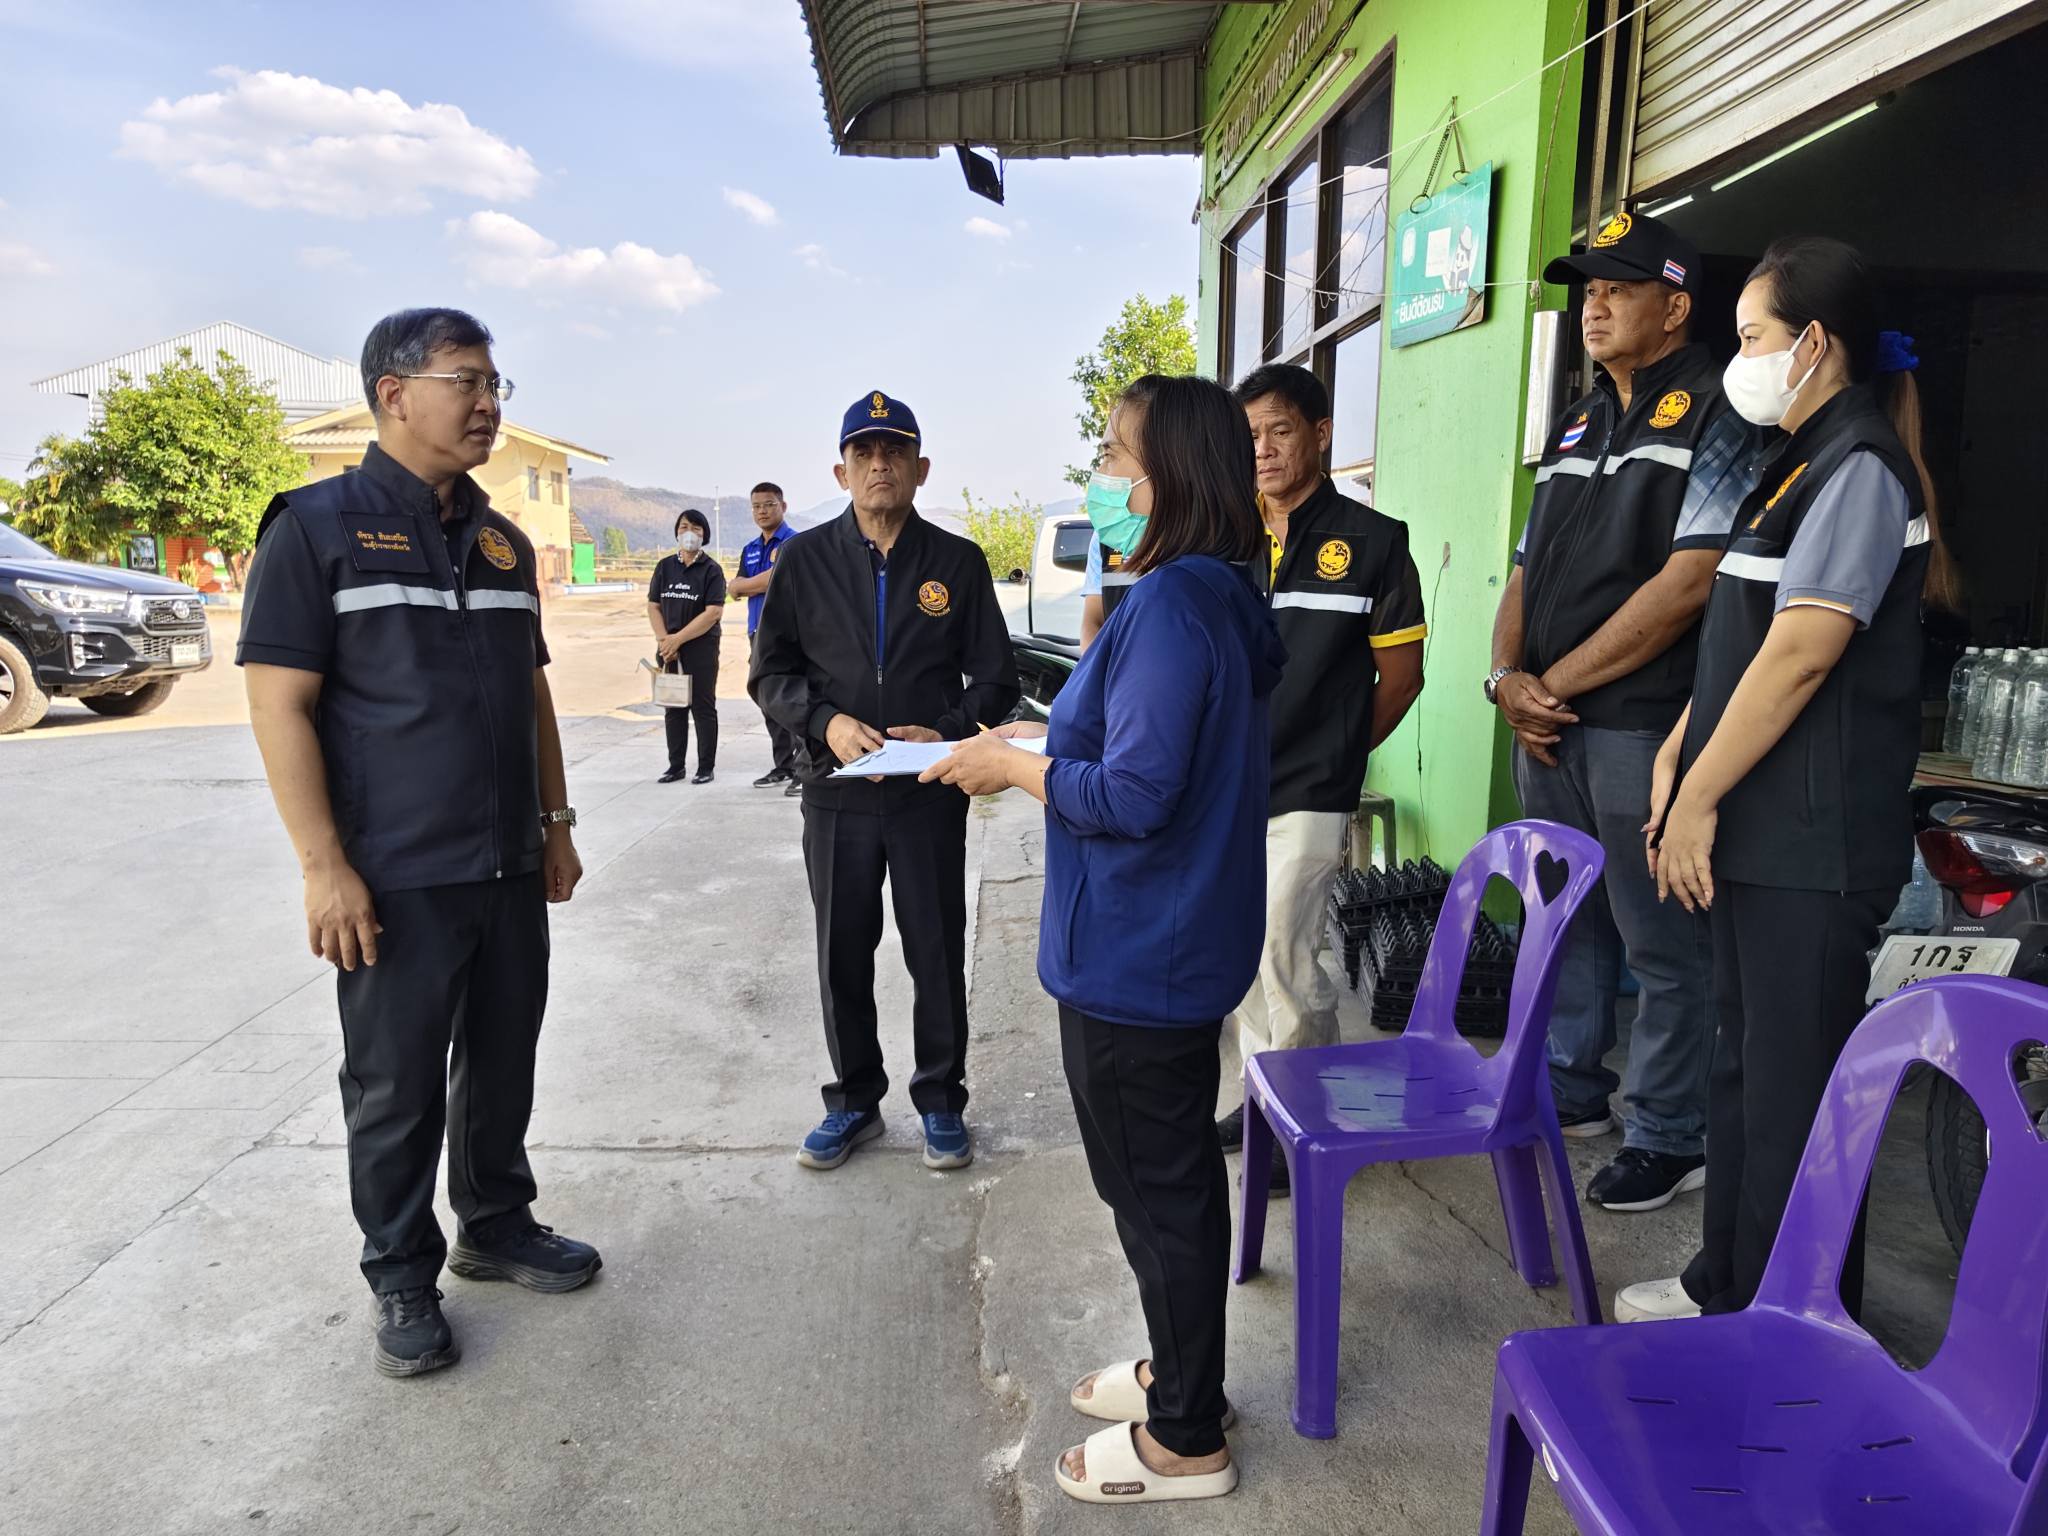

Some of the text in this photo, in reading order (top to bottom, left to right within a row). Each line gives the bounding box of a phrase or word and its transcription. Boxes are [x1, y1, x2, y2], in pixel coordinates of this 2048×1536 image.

[1399, 287, 1445, 324] ยินดีต้อนรับ
[1104, 1484, 1140, 1494] original
